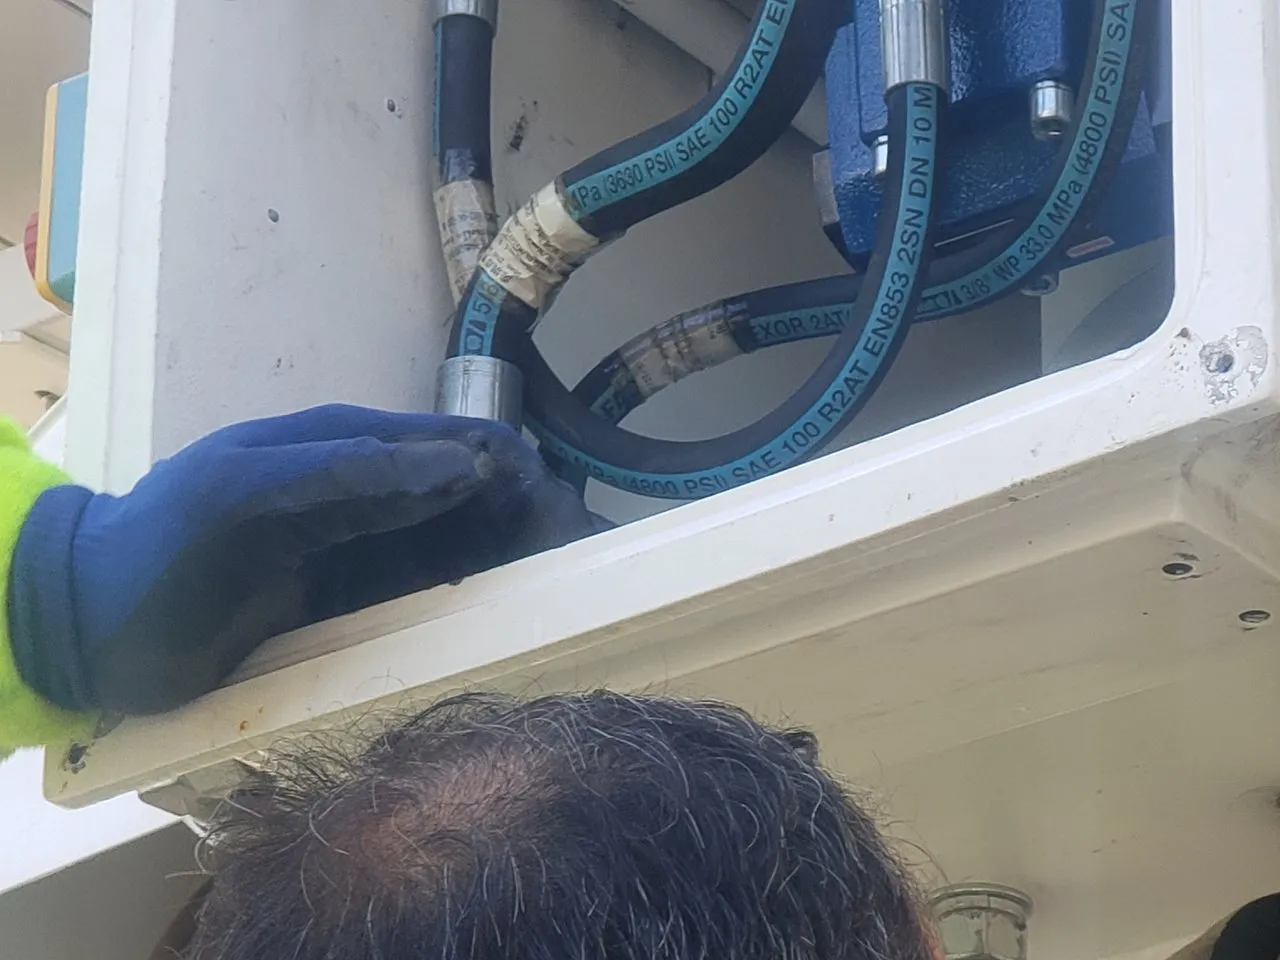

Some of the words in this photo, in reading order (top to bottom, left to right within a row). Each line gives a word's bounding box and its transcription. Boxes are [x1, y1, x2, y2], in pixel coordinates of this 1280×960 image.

[602, 163, 644, 196] (3630
[644, 154, 676, 179] PSI)
[676, 126, 711, 162] SAE
[709, 97, 739, 134] 100
[733, 28, 774, 100] R2AT
[914, 117, 932, 146] 10
[908, 157, 929, 198] DN
[993, 258, 1020, 282] WP
[1019, 224, 1055, 261] 33.0
[1047, 179, 1084, 226] MPa
[1072, 111, 1108, 175] (4800
[1095, 50, 1122, 104] PSI)
[898, 208, 923, 266] 2SN
[863, 271, 910, 358] EN853
[818, 360, 869, 422] R2AT
[782, 421, 821, 455] 100
[684, 474, 728, 496] PSI)
[731, 450, 782, 484] SAE
